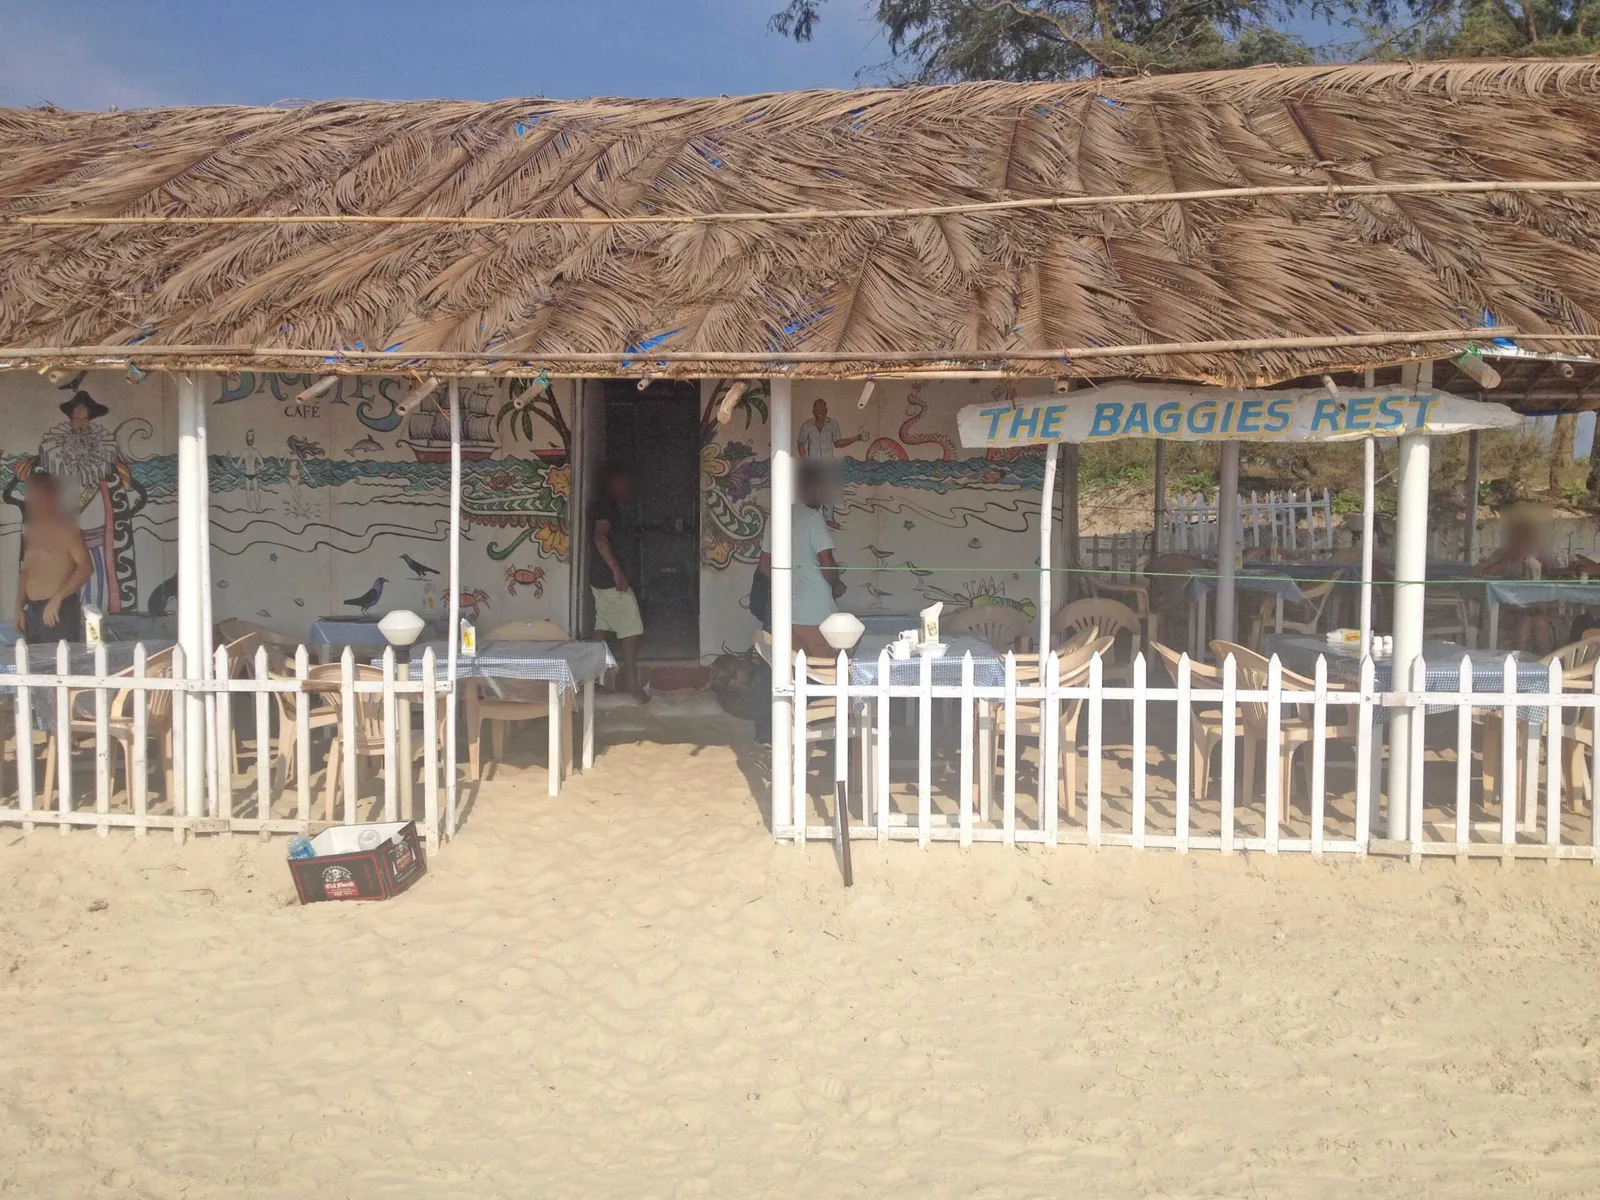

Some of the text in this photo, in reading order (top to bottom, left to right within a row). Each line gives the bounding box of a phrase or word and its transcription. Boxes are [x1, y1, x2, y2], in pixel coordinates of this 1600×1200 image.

[284, 402, 321, 418] CAFÉ
[979, 404, 1071, 443] THE
[1310, 395, 1439, 433] REST
